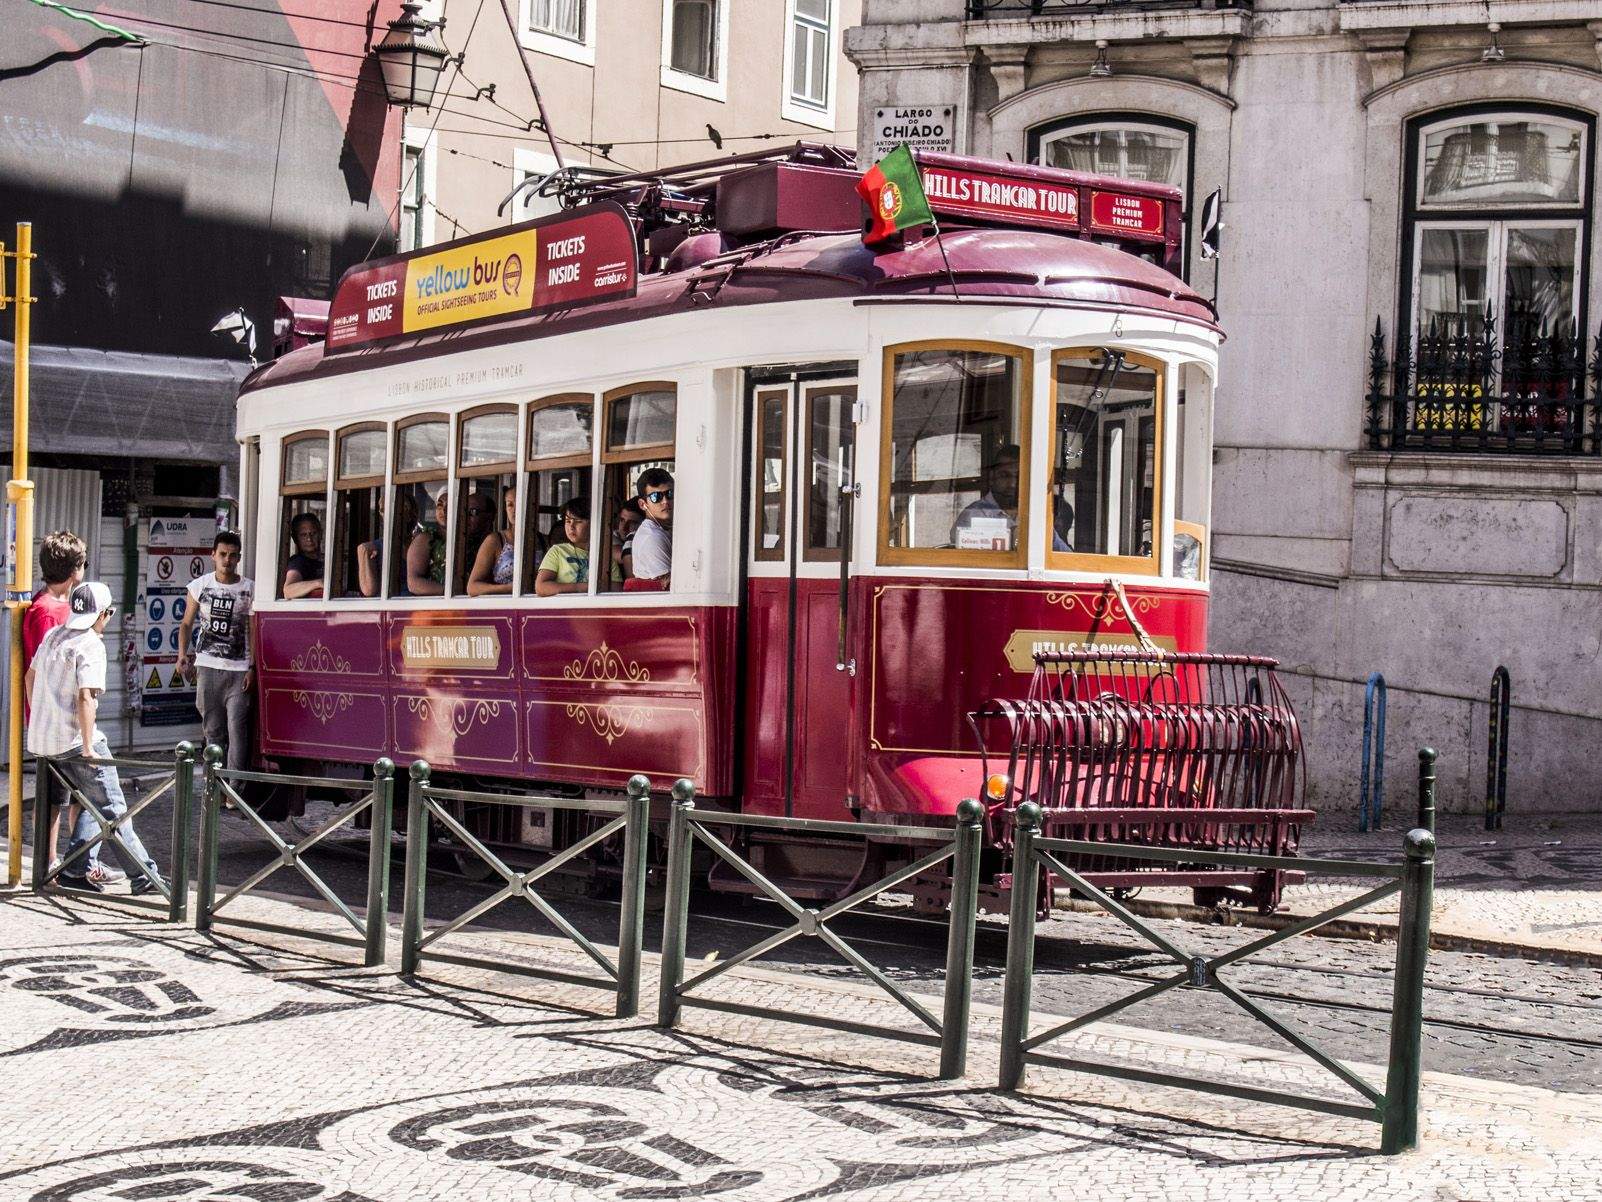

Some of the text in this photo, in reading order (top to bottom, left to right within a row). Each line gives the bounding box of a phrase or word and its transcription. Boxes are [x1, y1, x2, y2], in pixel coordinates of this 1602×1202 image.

[895, 109, 933, 118] LARGO
[882, 125, 944, 138] CHIADO
[923, 173, 1077, 215] HILLS TRAMCAR TOUR
[1115, 197, 1140, 208] LISBON
[1112, 207, 1143, 218] PREMIUM
[1112, 217, 1143, 228] TRAMCAR
[546, 235, 586, 260] TICKETS
[474, 256, 502, 286] bus
[548, 262, 580, 286] INSIDE
[366, 279, 397, 302] TICKETS
[417, 289, 497, 316] OFFICIAL SIGHTSEEING TOURS
[367, 303, 393, 324] INSIDE
[387, 363, 525, 397] LISBON HISTORICAL PREMIUM TRAMCAR
[166, 522, 188, 531] UDRA
[213, 599, 233, 609] BLN
[211, 620, 228, 634] 99
[406, 635, 494, 660] HILLS TRAMCAR TOUR
